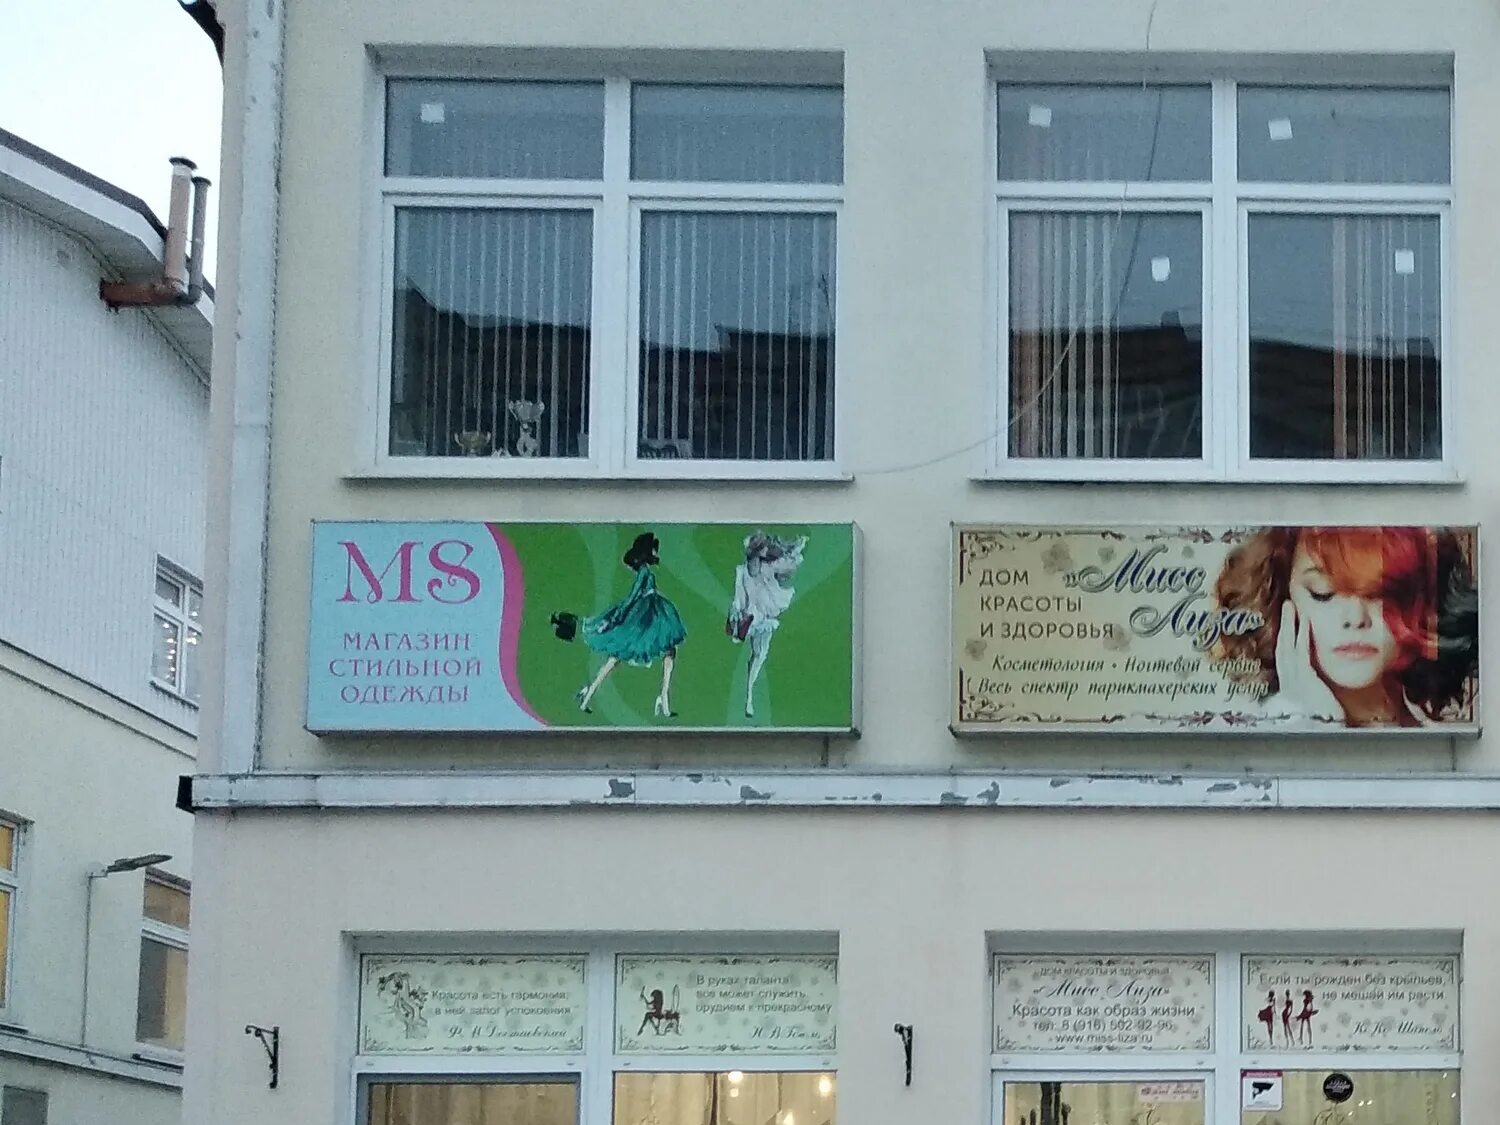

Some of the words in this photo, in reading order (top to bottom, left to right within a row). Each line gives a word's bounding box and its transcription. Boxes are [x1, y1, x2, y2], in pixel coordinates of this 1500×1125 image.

[336, 539, 481, 605] MS
[979, 569, 1029, 587] ДОМ
[980, 596, 1082, 613] КРАСОТЫ
[980, 623, 994, 638] И
[1001, 622, 1114, 640] ЗДОРОВЬЯ
[343, 631, 470, 651] МАГАЗИН
[329, 656, 481, 677] СТИЛЬНОЙ
[992, 654, 1104, 673] Косметология
[1124, 656, 1201, 673] Ногтевой
[340, 684, 468, 705] ОДЕЖДЫ
[979, 677, 1012, 695] Весь
[1021, 678, 1078, 702] спектр
[1088, 678, 1217, 701] парикмахерских
[1013, 1004, 1071, 1017] Красота
[1077, 1006, 1099, 1016] как
[1104, 1003, 1146, 1017] образ
[1151, 1006, 1195, 1016] жизни
